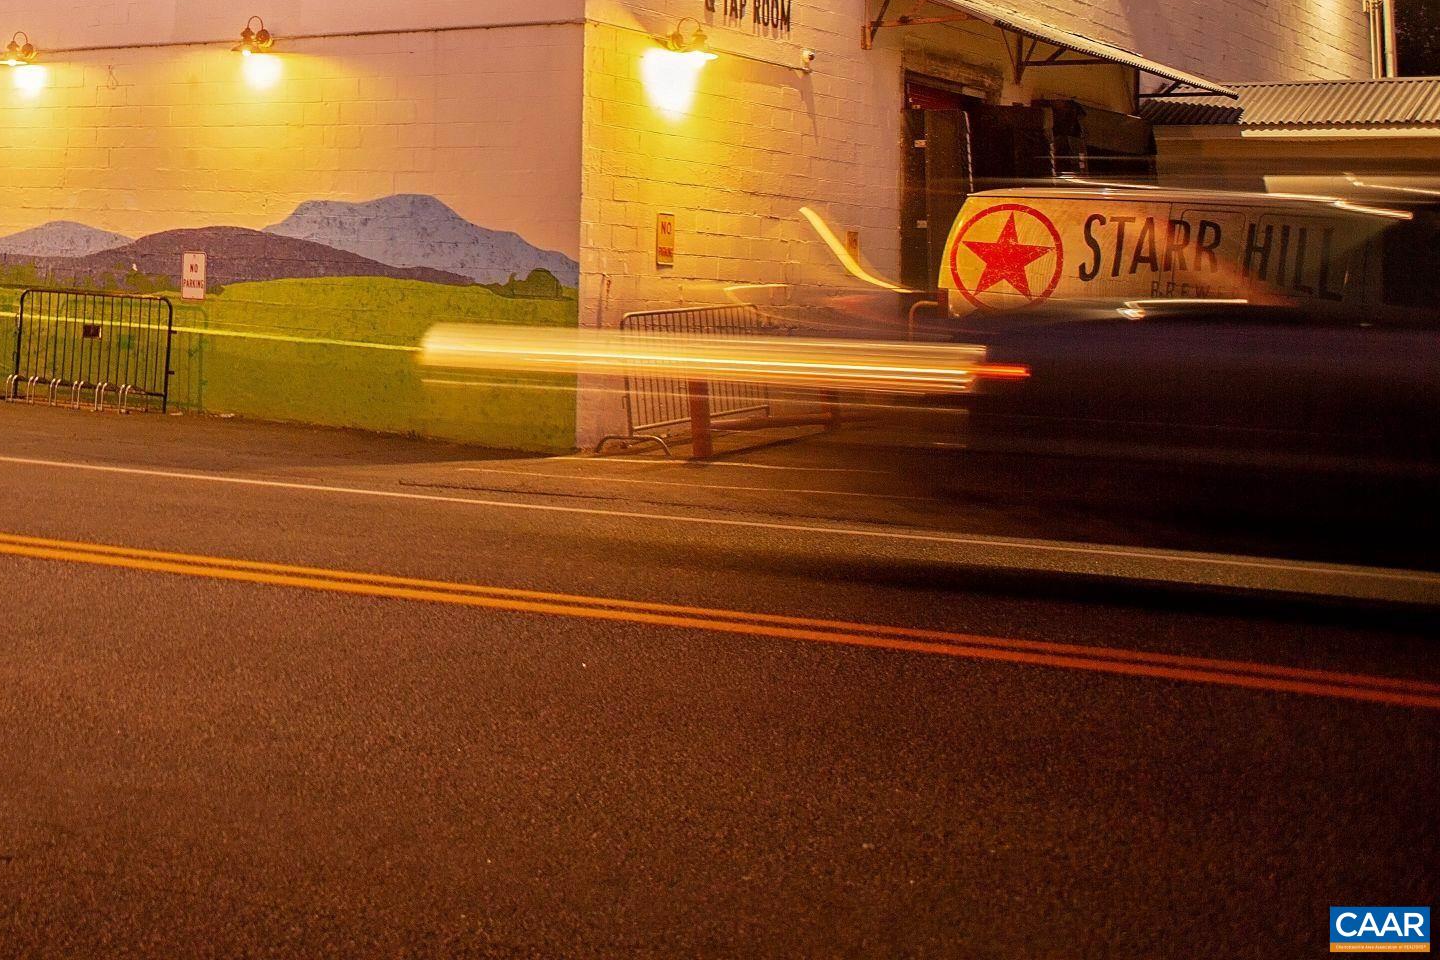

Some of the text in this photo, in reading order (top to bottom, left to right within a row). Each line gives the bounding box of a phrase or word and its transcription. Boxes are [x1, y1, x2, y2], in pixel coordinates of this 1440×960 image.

[661, 221, 672, 235] NO
[1078, 213, 1343, 302] STARR HILL
[190, 264, 199, 273] NO
[183, 279, 204, 289] PARKING
